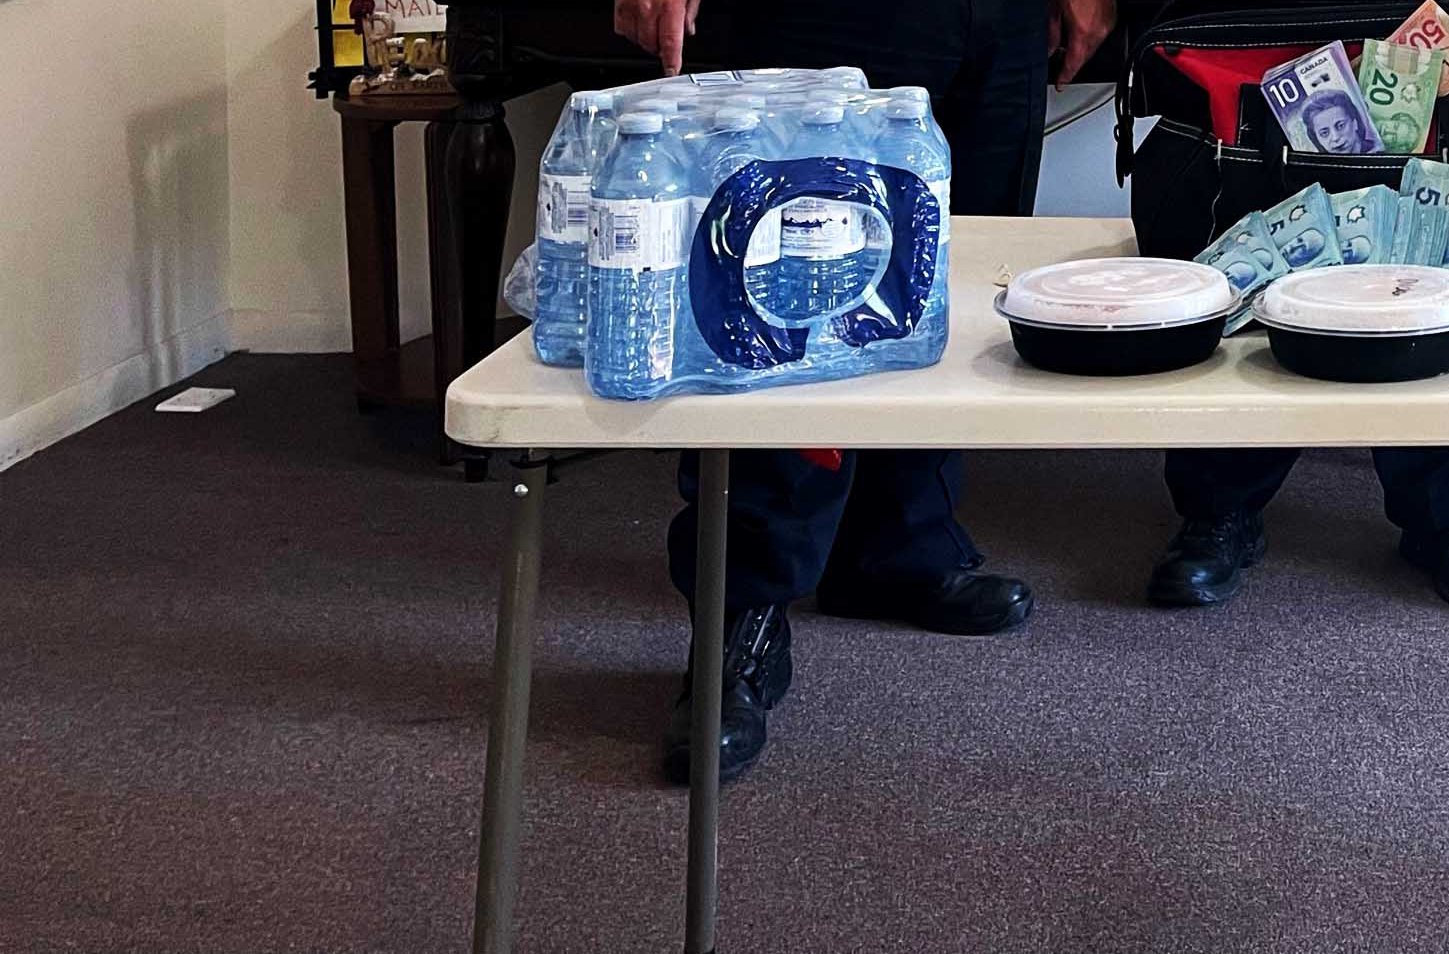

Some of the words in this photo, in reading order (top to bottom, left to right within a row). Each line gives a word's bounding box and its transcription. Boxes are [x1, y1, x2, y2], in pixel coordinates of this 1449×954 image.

[1300, 56, 1329, 76] CANADA
[1269, 77, 1300, 108] 10
[1369, 68, 1399, 107] 20
[1415, 186, 1441, 207] 5
